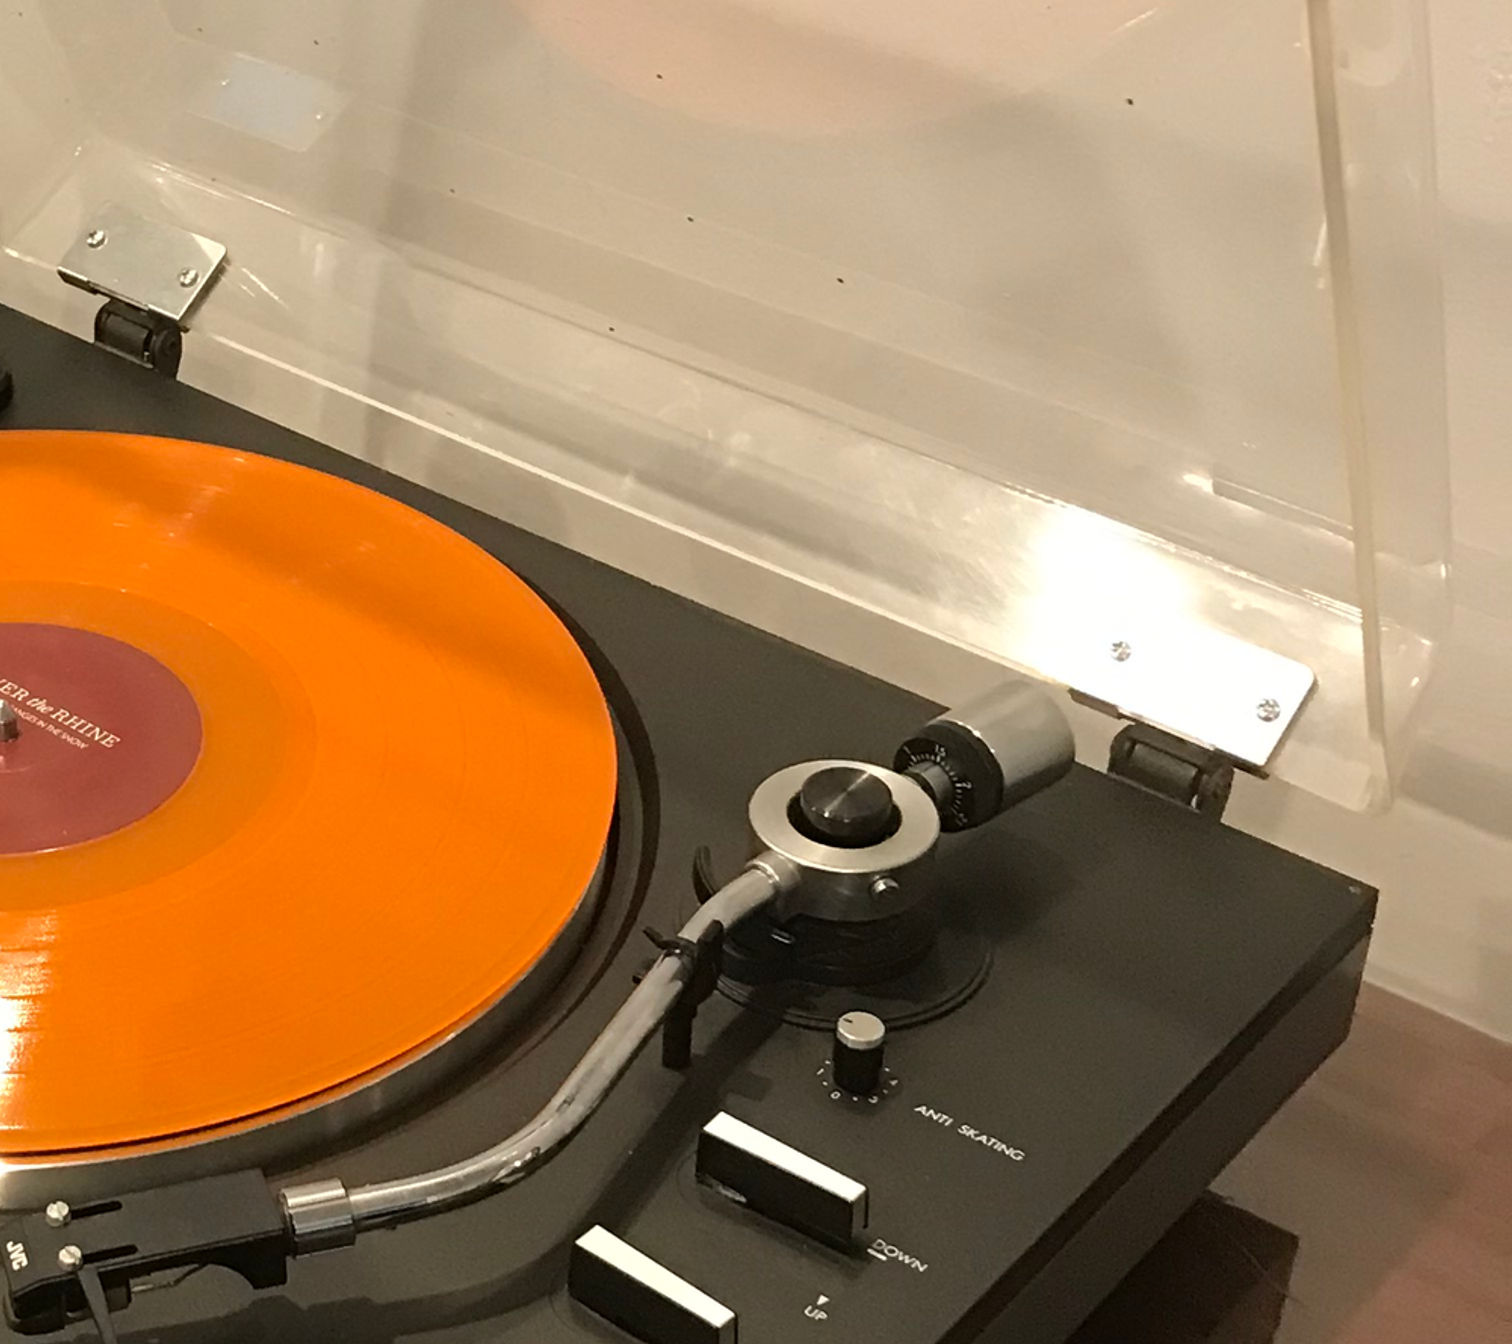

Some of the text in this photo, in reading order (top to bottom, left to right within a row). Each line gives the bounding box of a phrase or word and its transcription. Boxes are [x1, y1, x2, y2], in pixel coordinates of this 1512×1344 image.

[26, 697, 54, 714] the
[51, 708, 121, 748] RHINE
[914, 1105, 1026, 1161] ANTI SKATING
[6, 1240, 29, 1271] JVC
[871, 1239, 928, 1272] DOWN
[804, 1305, 828, 1320] UP
